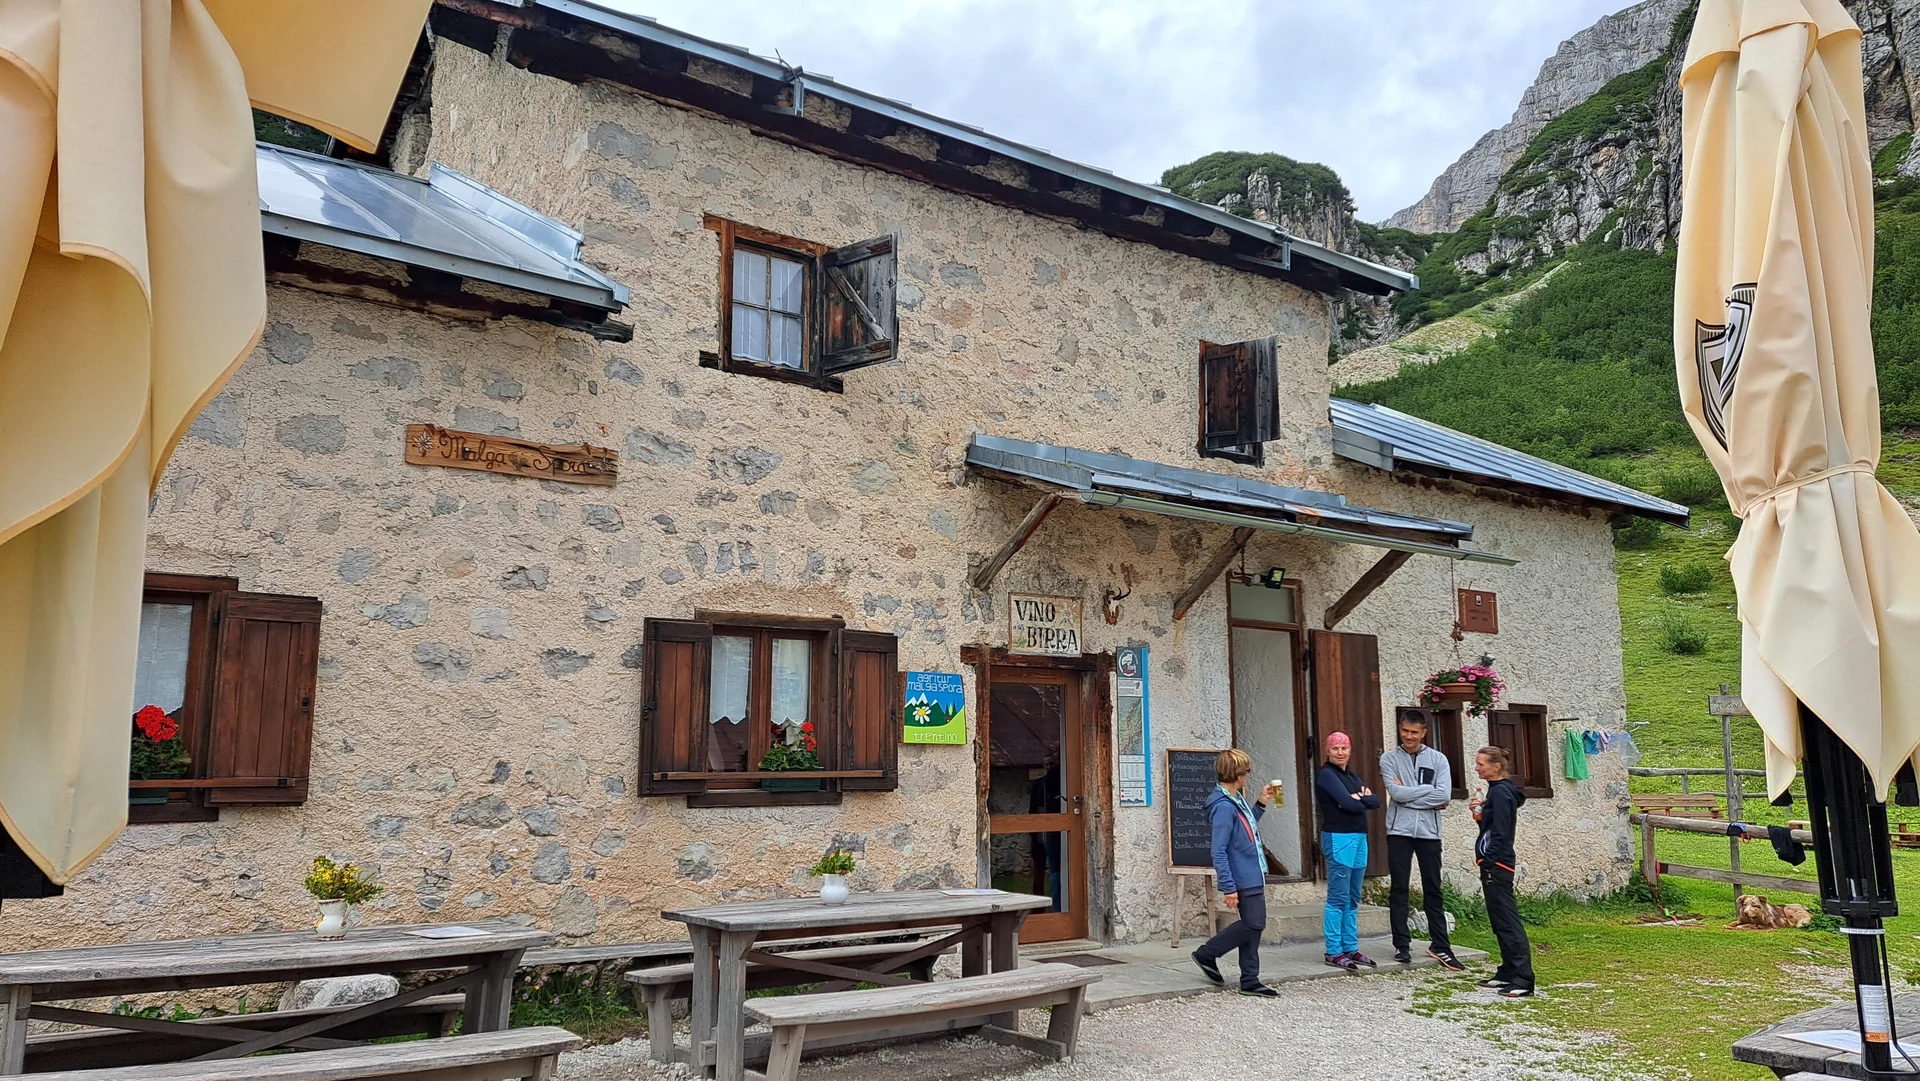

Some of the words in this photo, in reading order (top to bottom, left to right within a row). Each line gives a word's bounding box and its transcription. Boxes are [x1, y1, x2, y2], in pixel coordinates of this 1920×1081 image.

[439, 433, 507, 470] Malga
[533, 445, 588, 475] Spora
[1014, 600, 1056, 622] VINO
[1026, 626, 1078, 651] BIRRA
[917, 673, 953, 684] agritur
[913, 731, 958, 743] trentino
